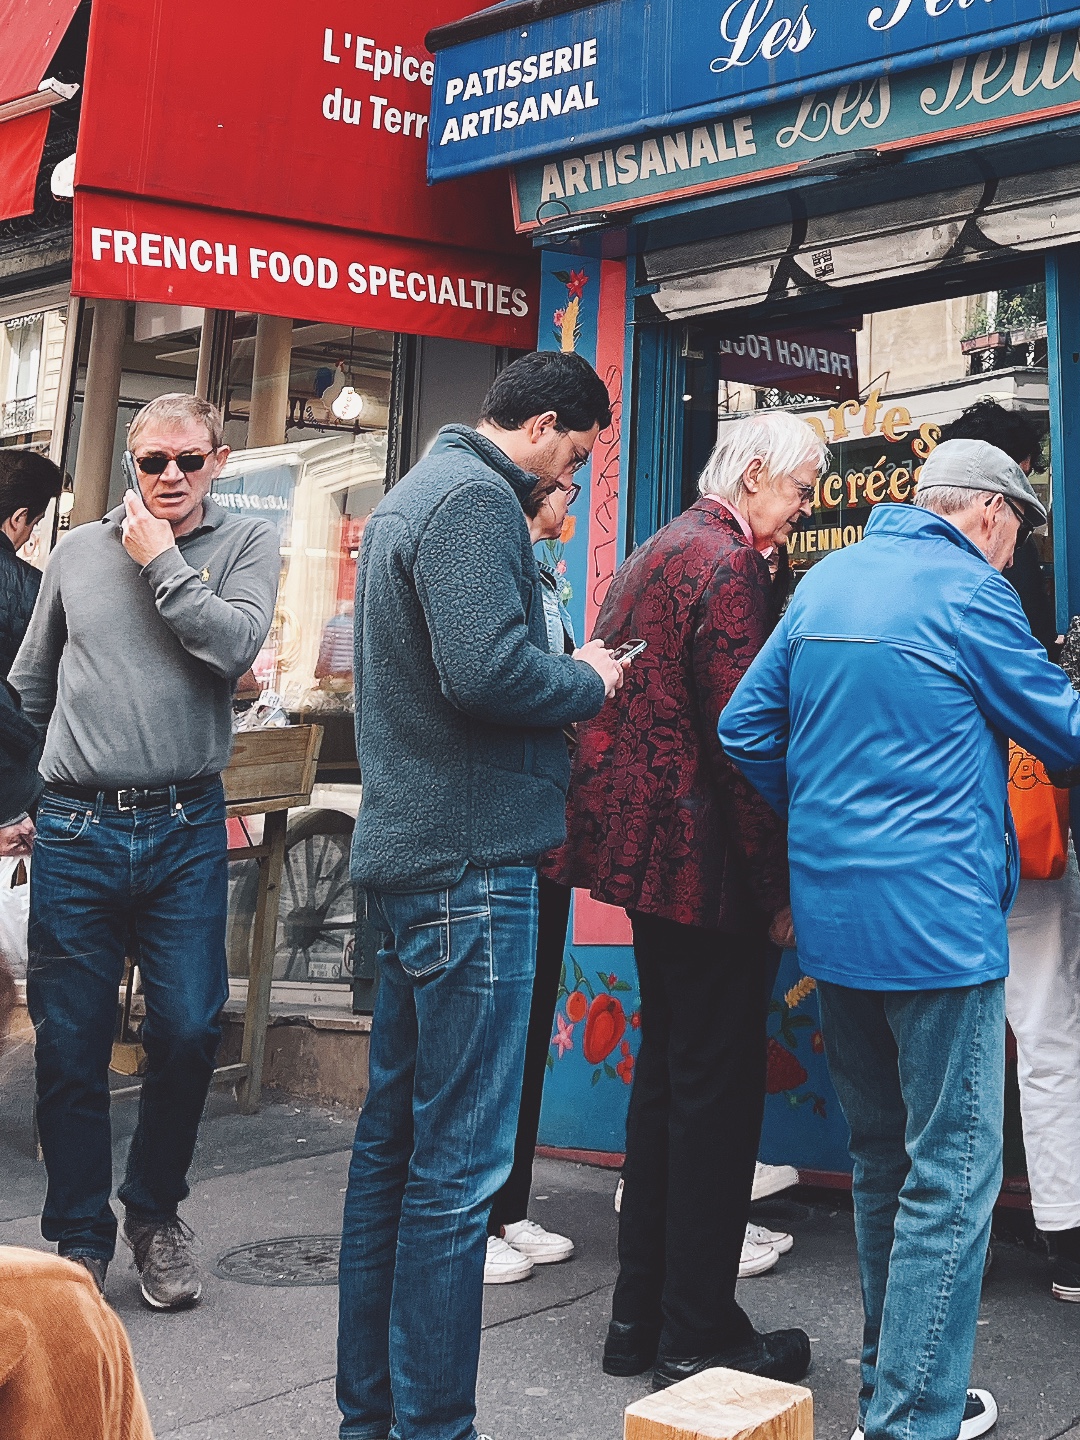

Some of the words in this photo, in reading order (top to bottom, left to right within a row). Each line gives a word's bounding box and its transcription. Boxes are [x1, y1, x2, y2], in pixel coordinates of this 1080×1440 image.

[445, 38, 597, 105] PATISSERIE
[322, 87, 361, 125] du
[369, 95, 430, 139] Terr
[439, 80, 599, 146] ARTISANAL
[540, 116, 757, 203] ARTISANALE
[90, 226, 239, 277] FRENCH
[249, 247, 339, 290] FOOD
[347, 263, 529, 318] SPECIALTIES
